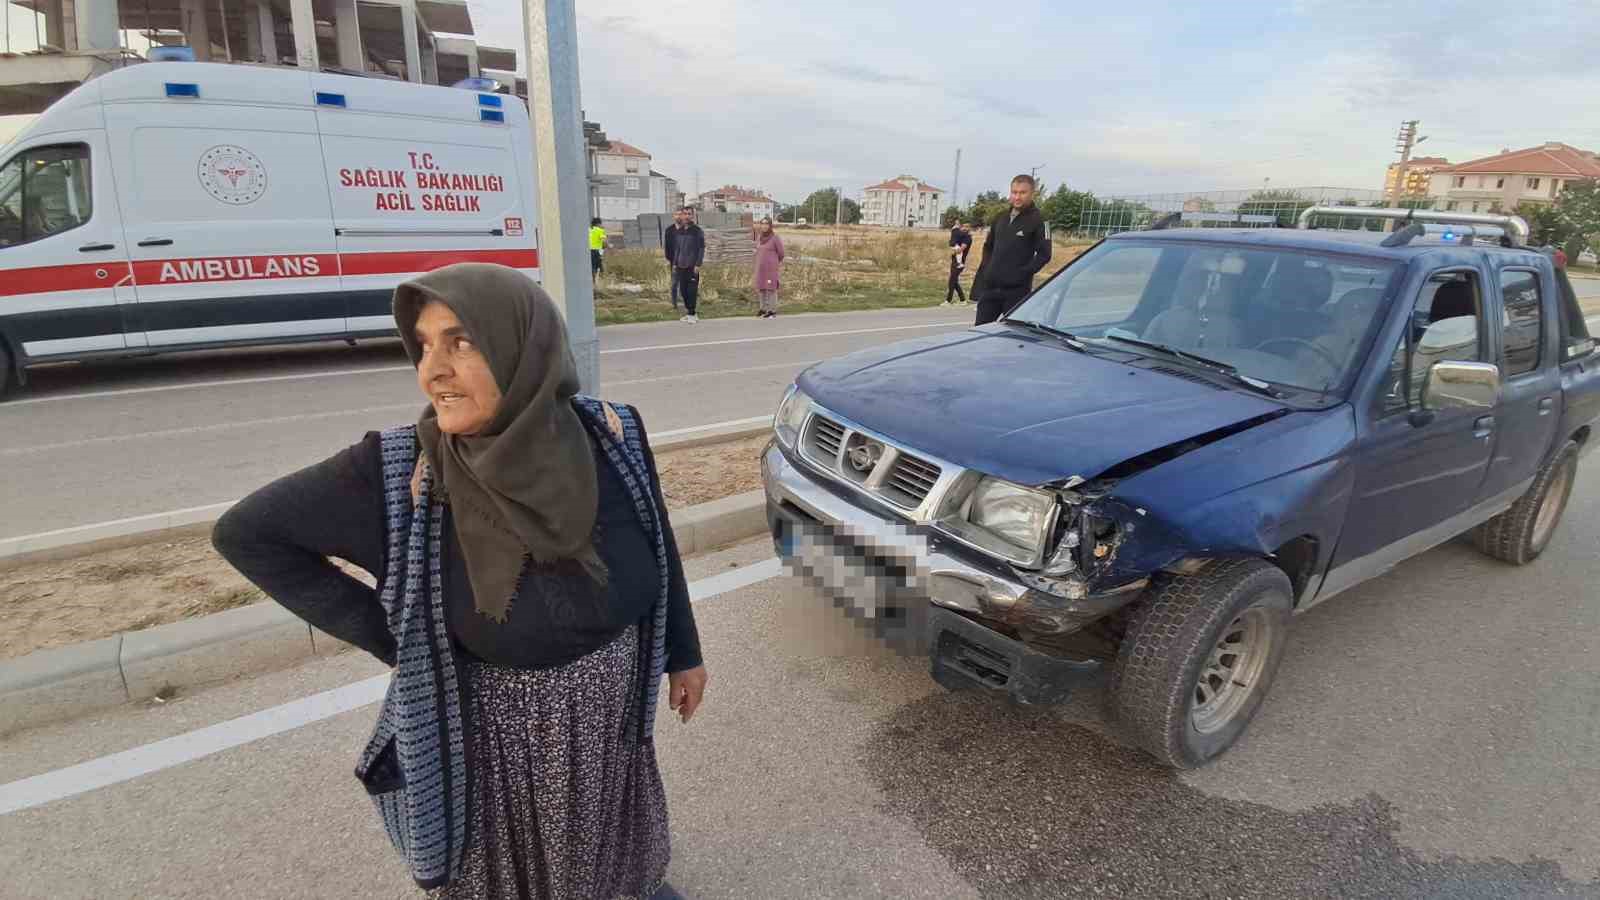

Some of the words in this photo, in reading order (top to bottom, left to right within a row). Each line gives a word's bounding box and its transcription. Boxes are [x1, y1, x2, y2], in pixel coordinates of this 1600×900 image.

[407, 152, 439, 170] T.C.
[339, 167, 407, 188] SAĞLIK
[417, 171, 504, 192] BAKANLIĞI
[376, 190, 415, 211] ACİL
[422, 192, 481, 212] SAĞLIK
[159, 256, 321, 282] AMBULANS
